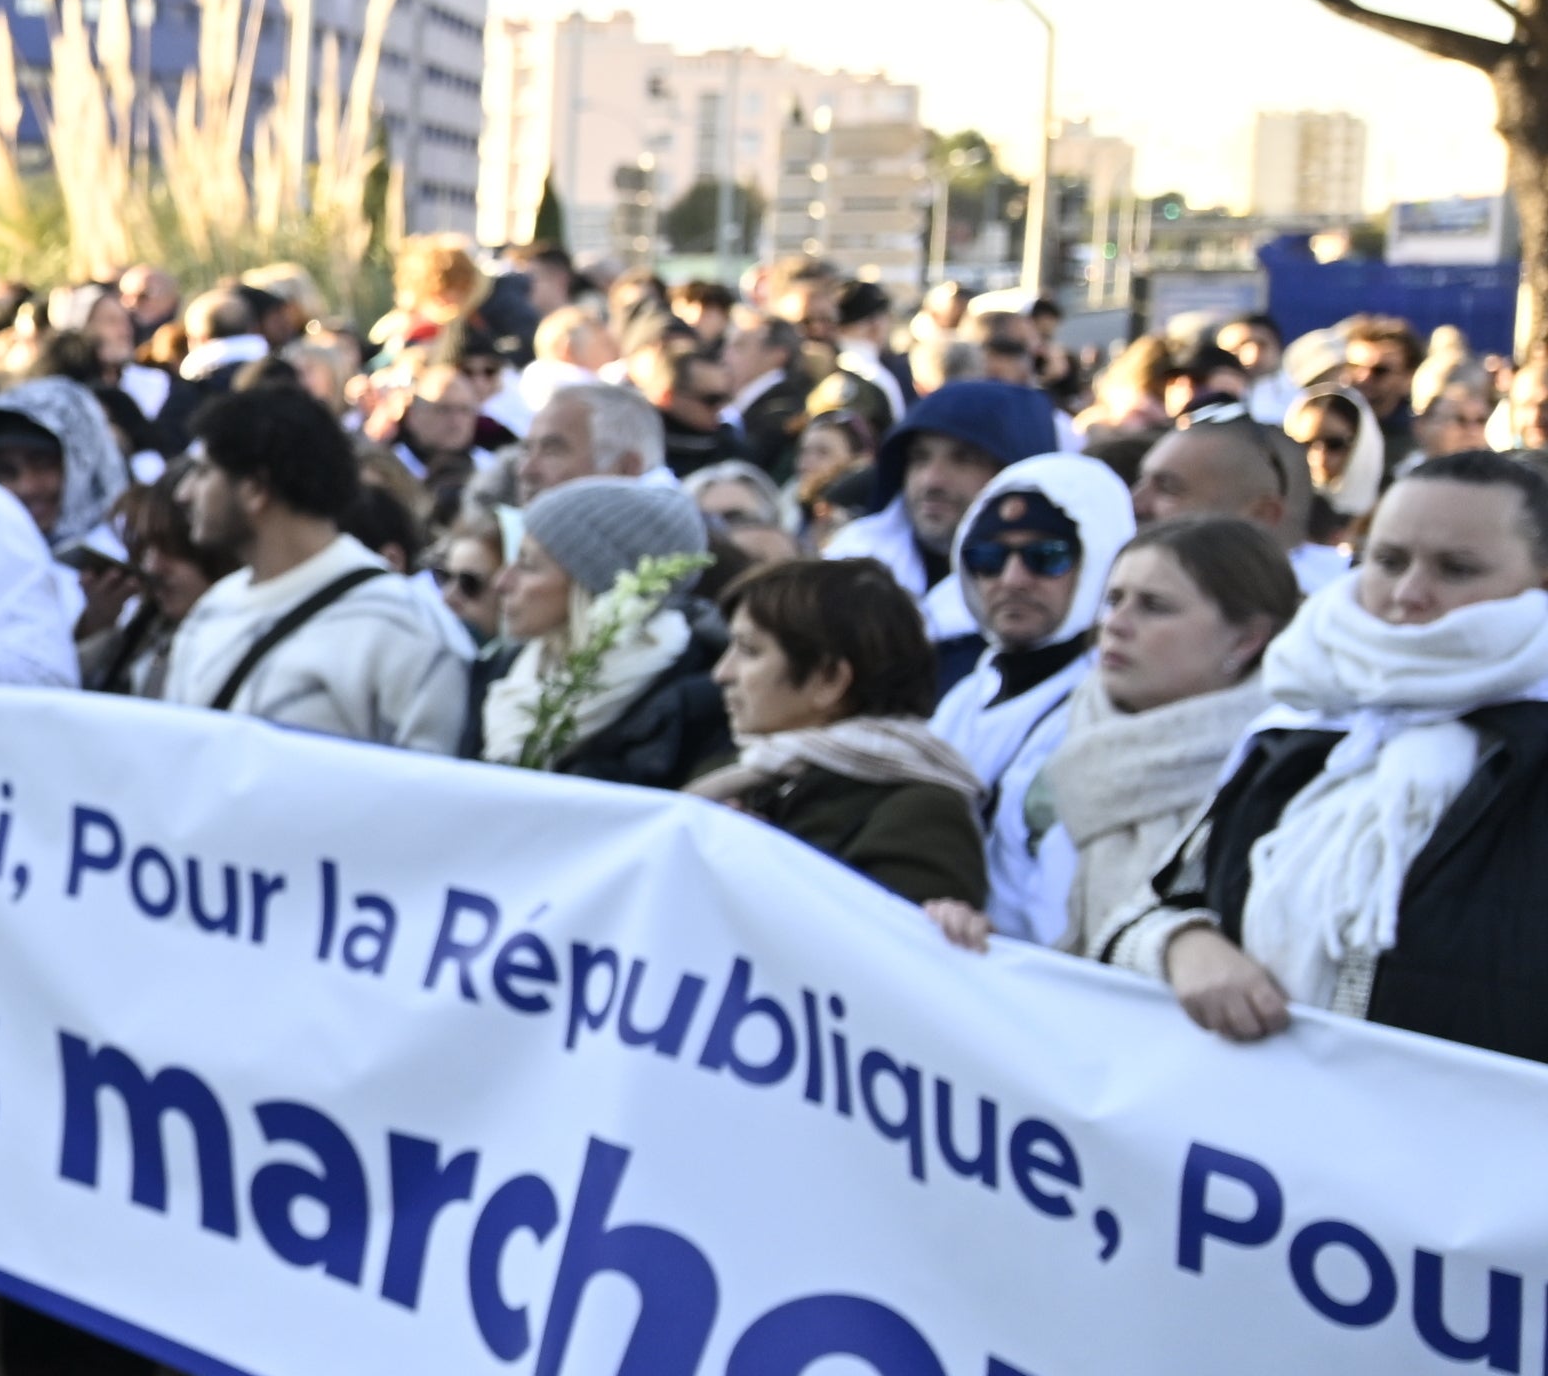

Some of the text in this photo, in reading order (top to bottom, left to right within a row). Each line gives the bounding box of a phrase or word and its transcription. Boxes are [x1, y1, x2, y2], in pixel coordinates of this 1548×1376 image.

[65, 803, 287, 946] Pour
[315, 857, 398, 977] la
[422, 885, 1123, 1265] République,
